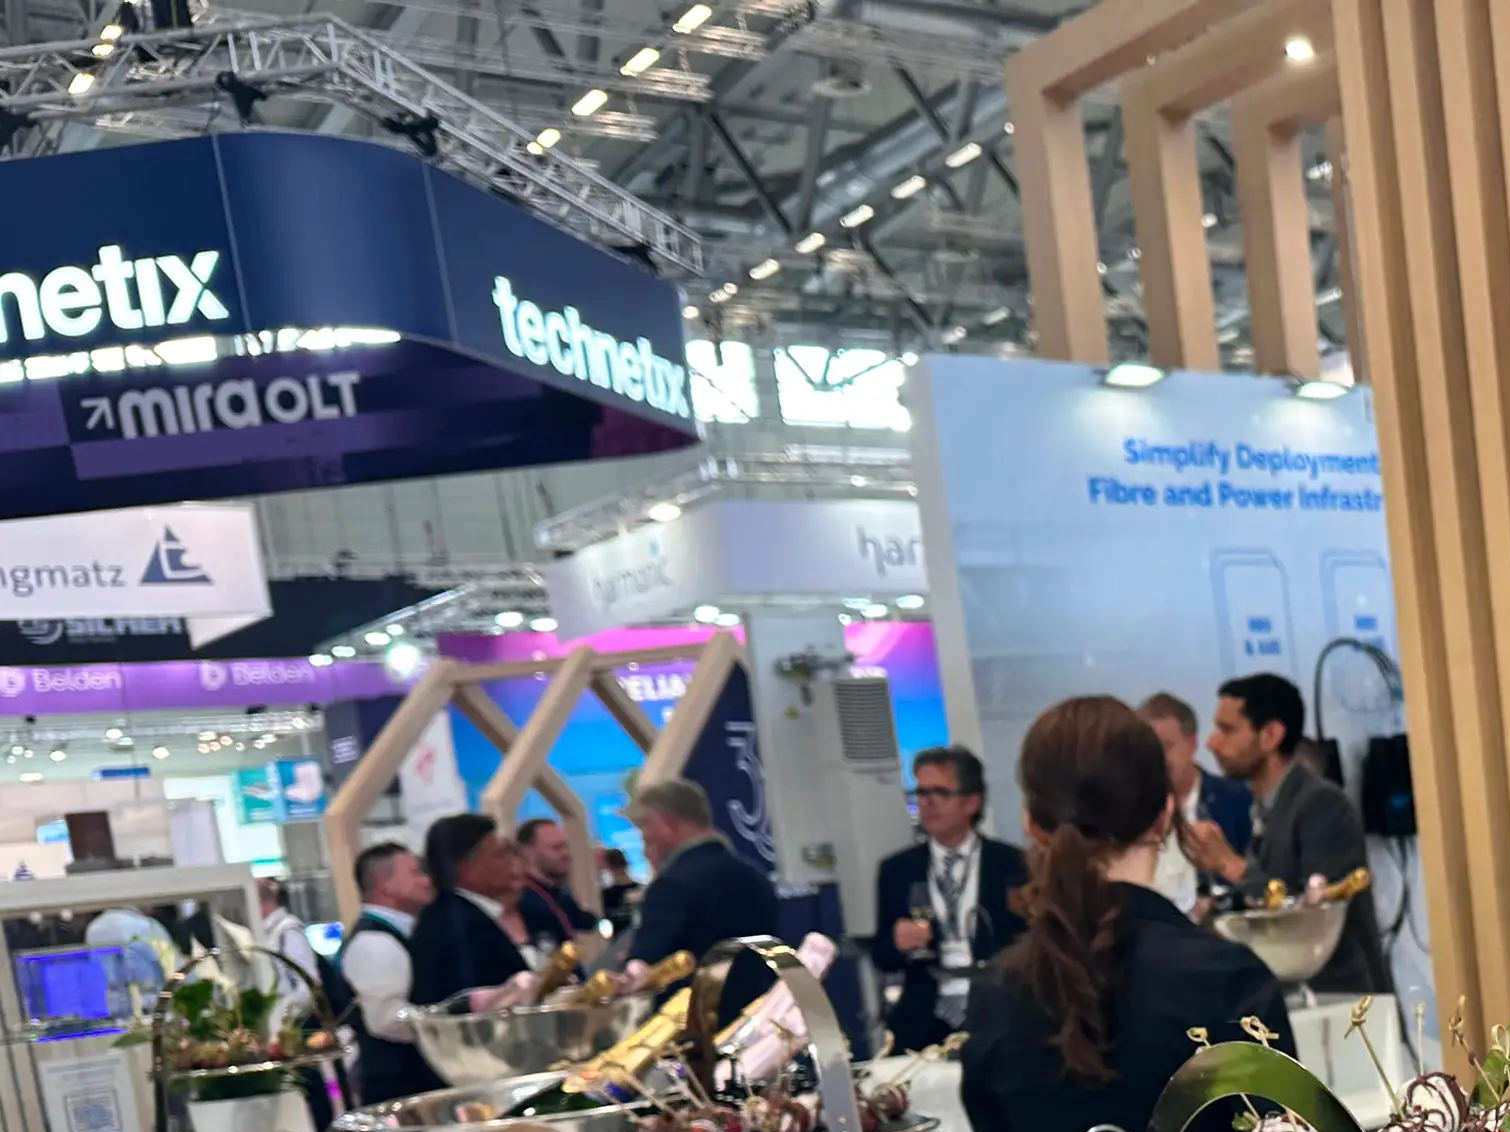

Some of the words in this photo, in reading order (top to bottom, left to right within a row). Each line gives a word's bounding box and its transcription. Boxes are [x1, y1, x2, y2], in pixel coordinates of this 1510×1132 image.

[492, 276, 690, 418] technetix
[1123, 438, 1230, 476] Simplify
[1236, 442, 1381, 479] Deployment
[1087, 476, 1157, 505] Fibre
[1163, 481, 1212, 507] and
[1217, 481, 1293, 509] Power
[32, 667, 122, 693] Belden
